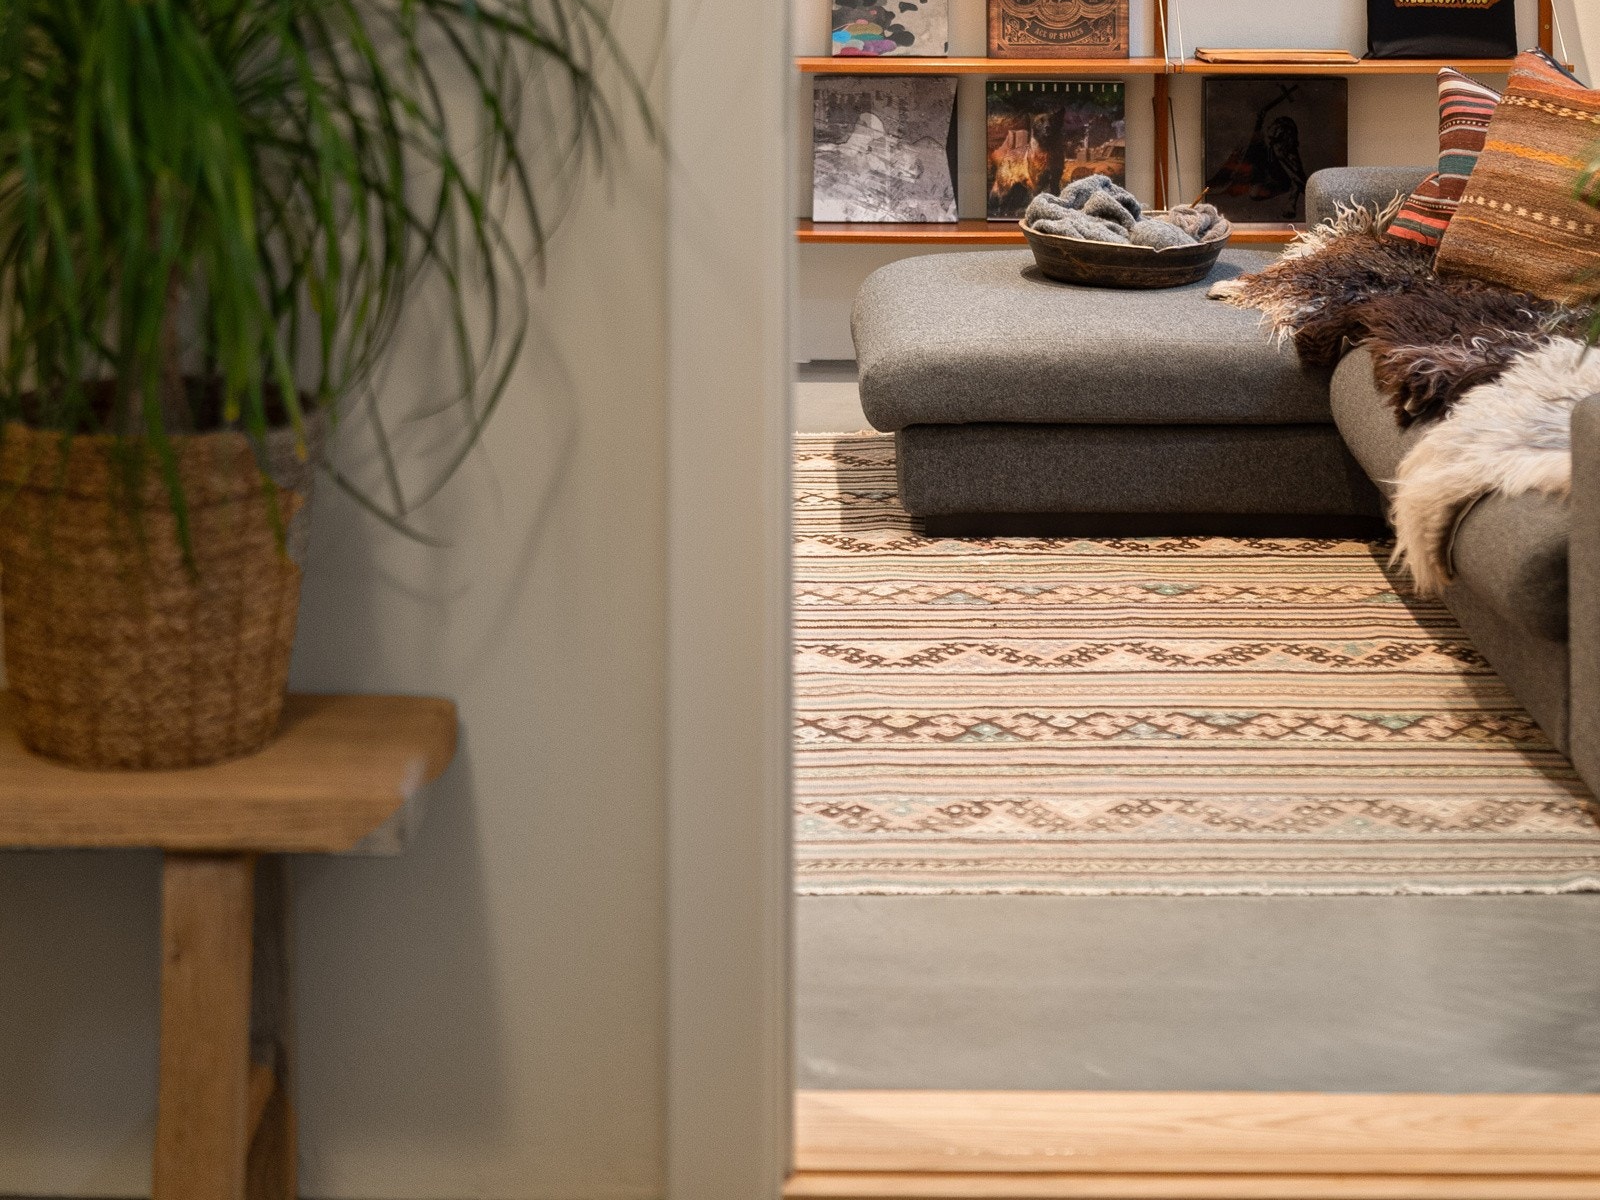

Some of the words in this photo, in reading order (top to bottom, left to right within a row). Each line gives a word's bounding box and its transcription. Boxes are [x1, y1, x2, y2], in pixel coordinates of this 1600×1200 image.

[1034, 27, 1047, 39] ACE
[1048, 32, 1058, 40] OF
[1059, 27, 1085, 40] SPADES
